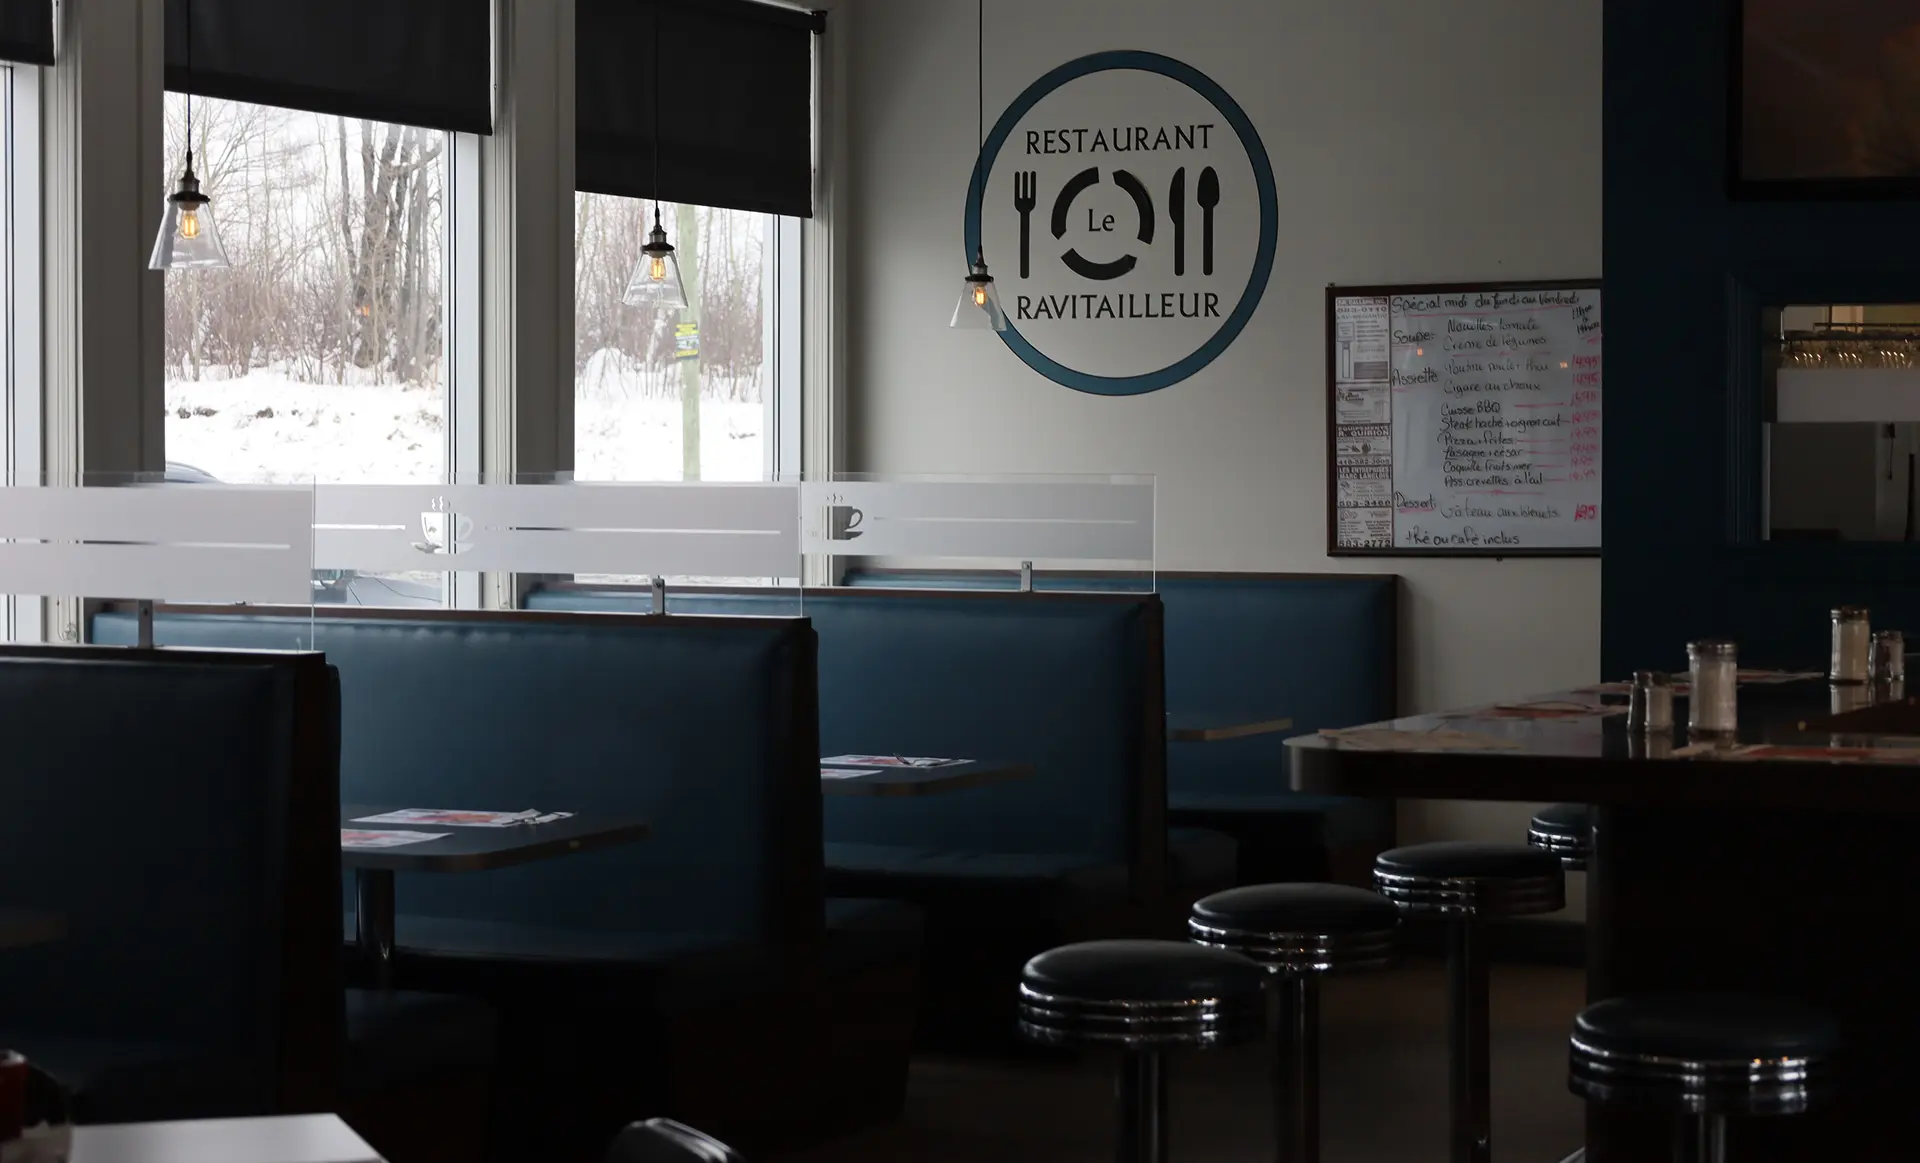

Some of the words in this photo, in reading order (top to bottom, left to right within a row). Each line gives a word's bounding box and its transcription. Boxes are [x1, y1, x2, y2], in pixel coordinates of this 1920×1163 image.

[1026, 123, 1214, 155] RESTAURANT
[1088, 208, 1115, 233] Le
[1016, 292, 1221, 320] RAVITAILLEUR
[1391, 295, 1440, 316] Spécial
[1445, 294, 1467, 308] midi
[1475, 293, 1490, 309] du
[1447, 317, 1494, 334] Nouilles
[1486, 334, 1498, 347] de
[1391, 367, 1439, 386] Assiette
[1443, 379, 1481, 399] Cigare
[1484, 383, 1501, 392] au
[1476, 400, 1501, 414] BBQ
[1440, 416, 1473, 432] Steak
[1350, 429, 1389, 437] QUIRION
[1483, 430, 1513, 445] frites
[1442, 460, 1482, 476] Coquille
[1484, 459, 1511, 473] fruits
[1514, 475, 1523, 485] à
[1405, 525, 1430, 544] thé
[1433, 535, 1449, 546] ou
[1450, 525, 1480, 546] café
[1483, 530, 1520, 545] inclus
